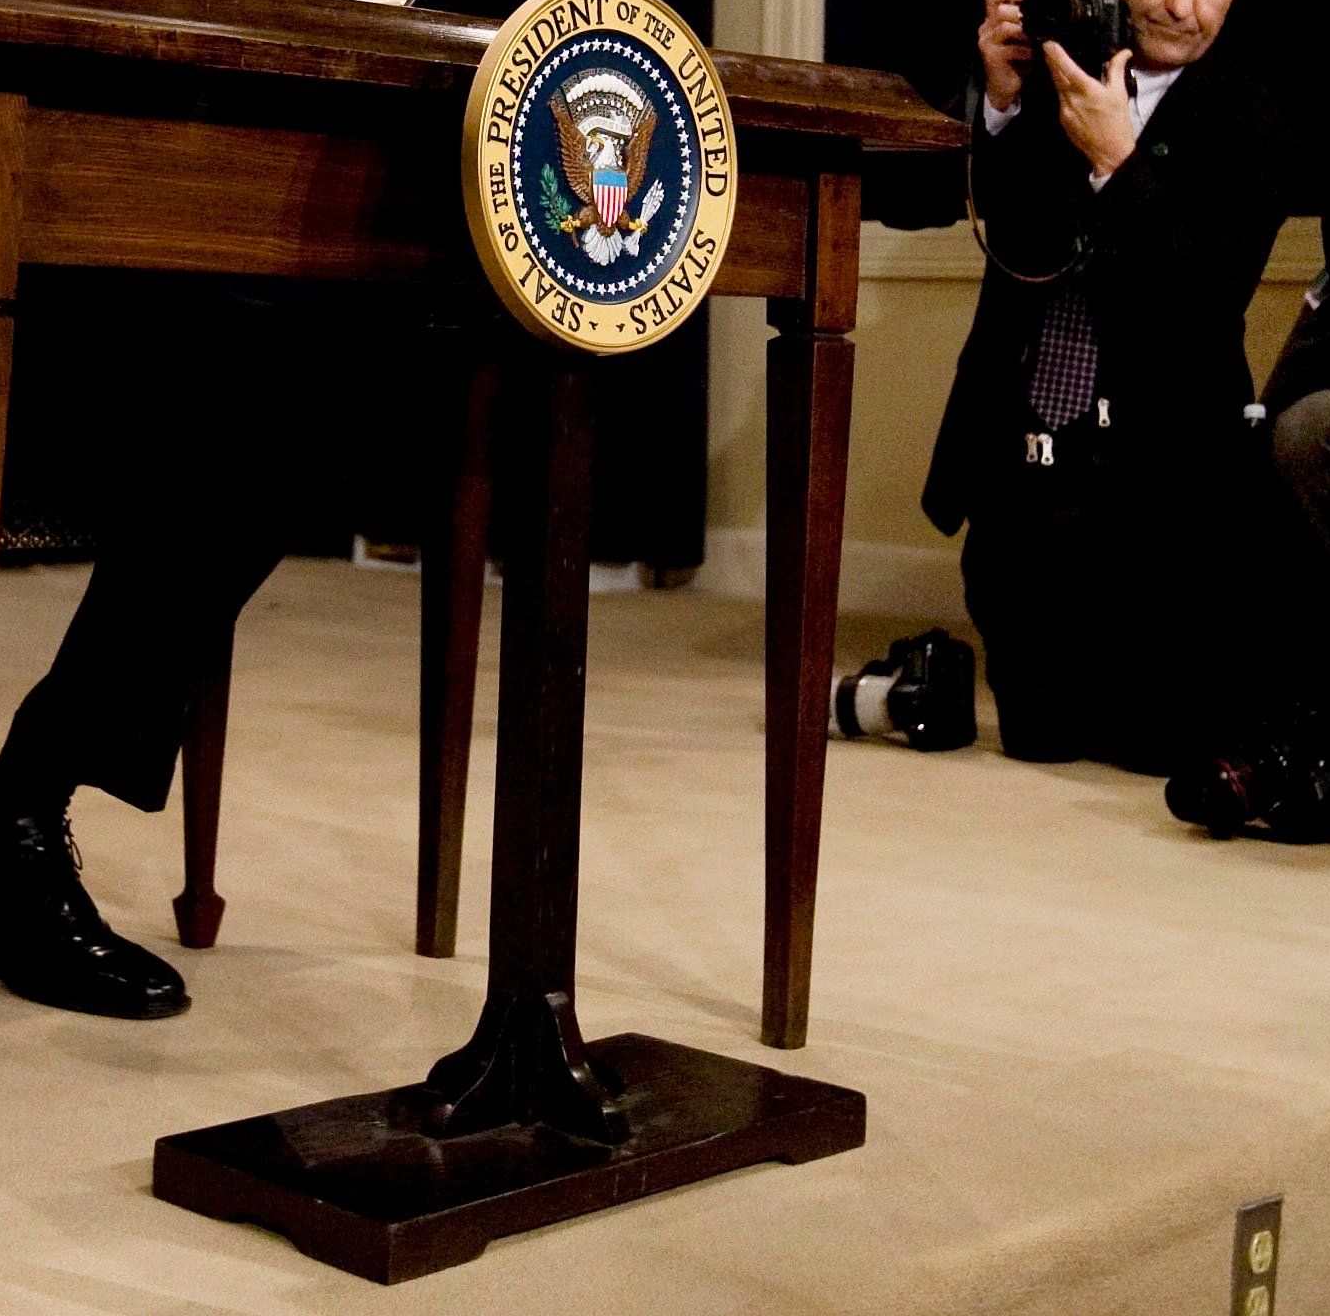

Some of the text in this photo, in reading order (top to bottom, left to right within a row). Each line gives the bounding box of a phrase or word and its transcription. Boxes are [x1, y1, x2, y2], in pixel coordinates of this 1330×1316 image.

[616, 0, 640, 25] OF
[643, 11, 676, 51] THE
[678, 48, 728, 198] UNITED
[489, 161, 508, 214] THE
[498, 221, 519, 252] OF
[519, 252, 584, 332] SEAL
[629, 229, 717, 335] STATES
